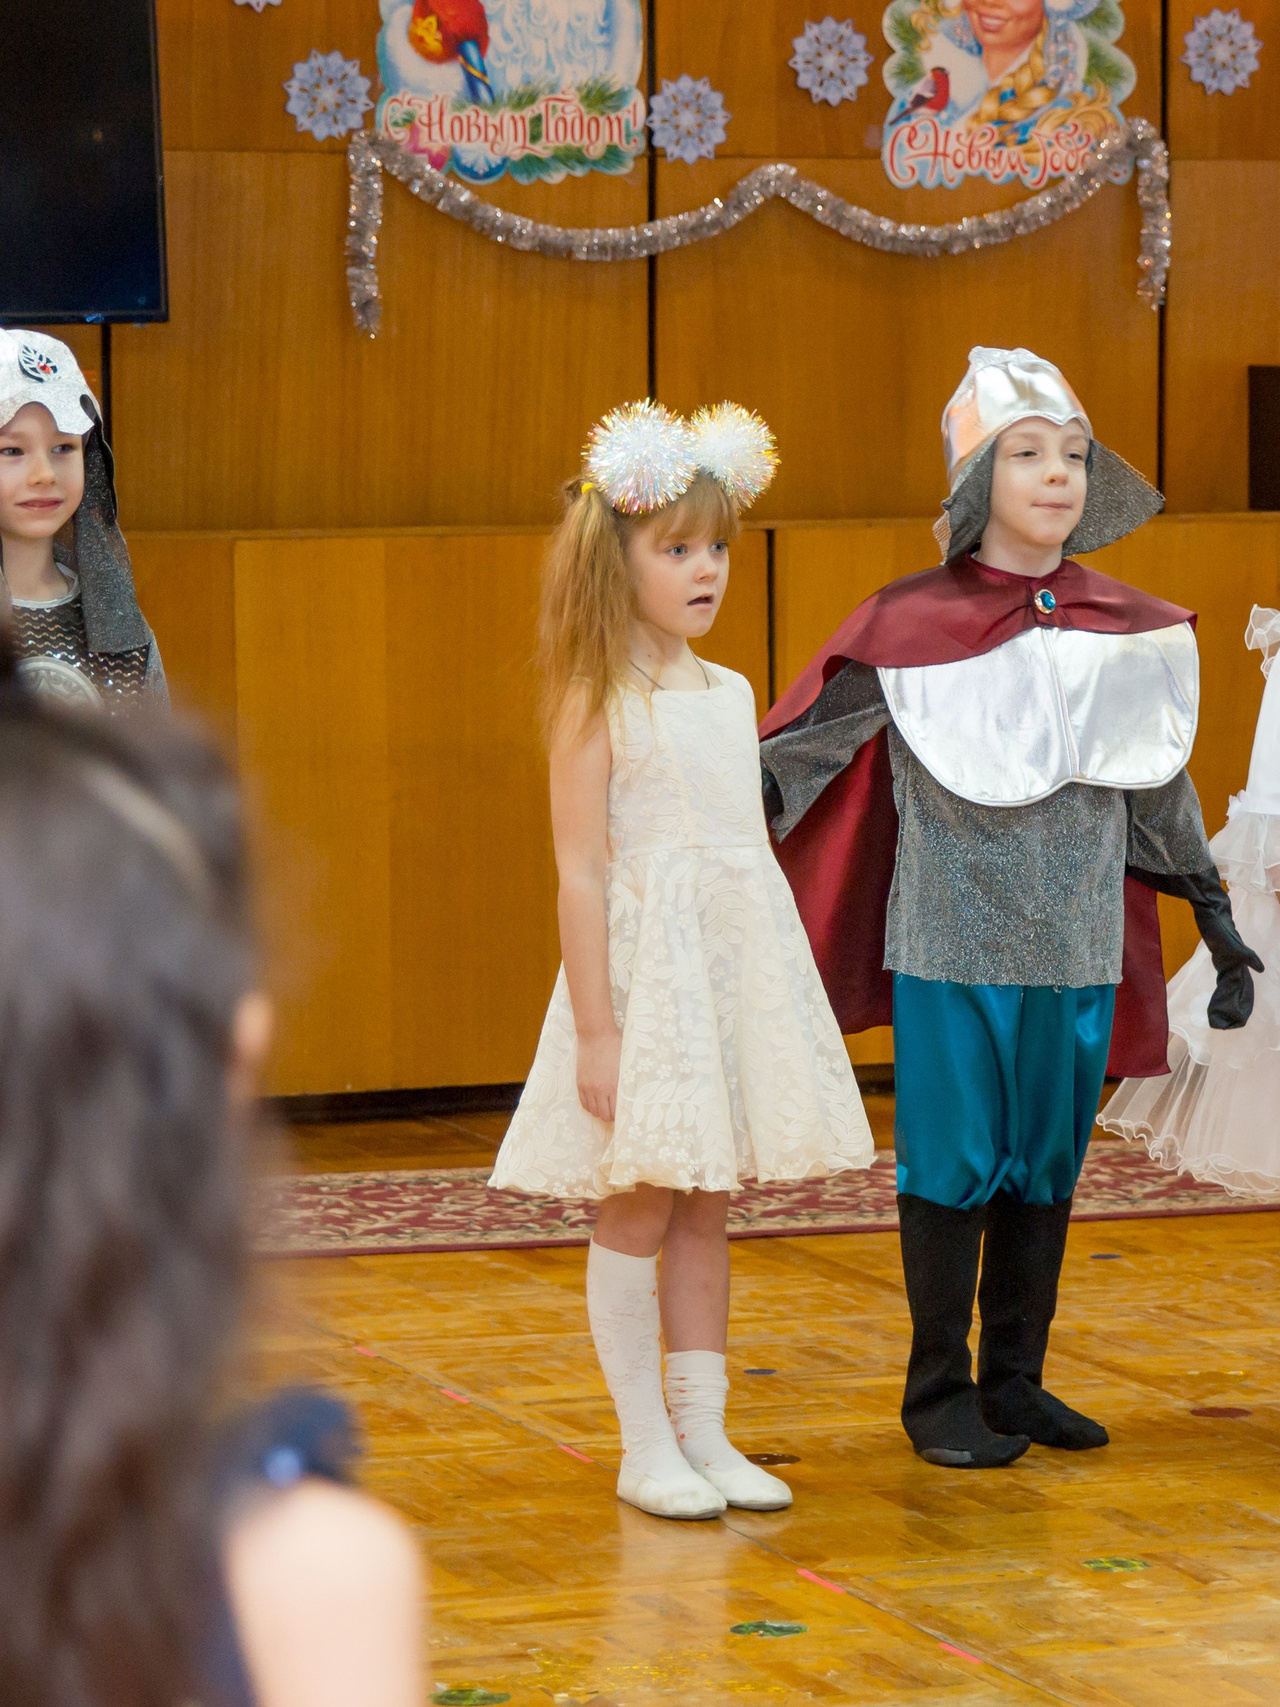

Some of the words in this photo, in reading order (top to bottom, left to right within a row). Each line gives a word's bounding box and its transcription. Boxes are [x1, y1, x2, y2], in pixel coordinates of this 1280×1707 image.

[409, 94, 549, 157] Новым
[540, 90, 638, 158] Годом!
[906, 117, 1029, 185] Новым
